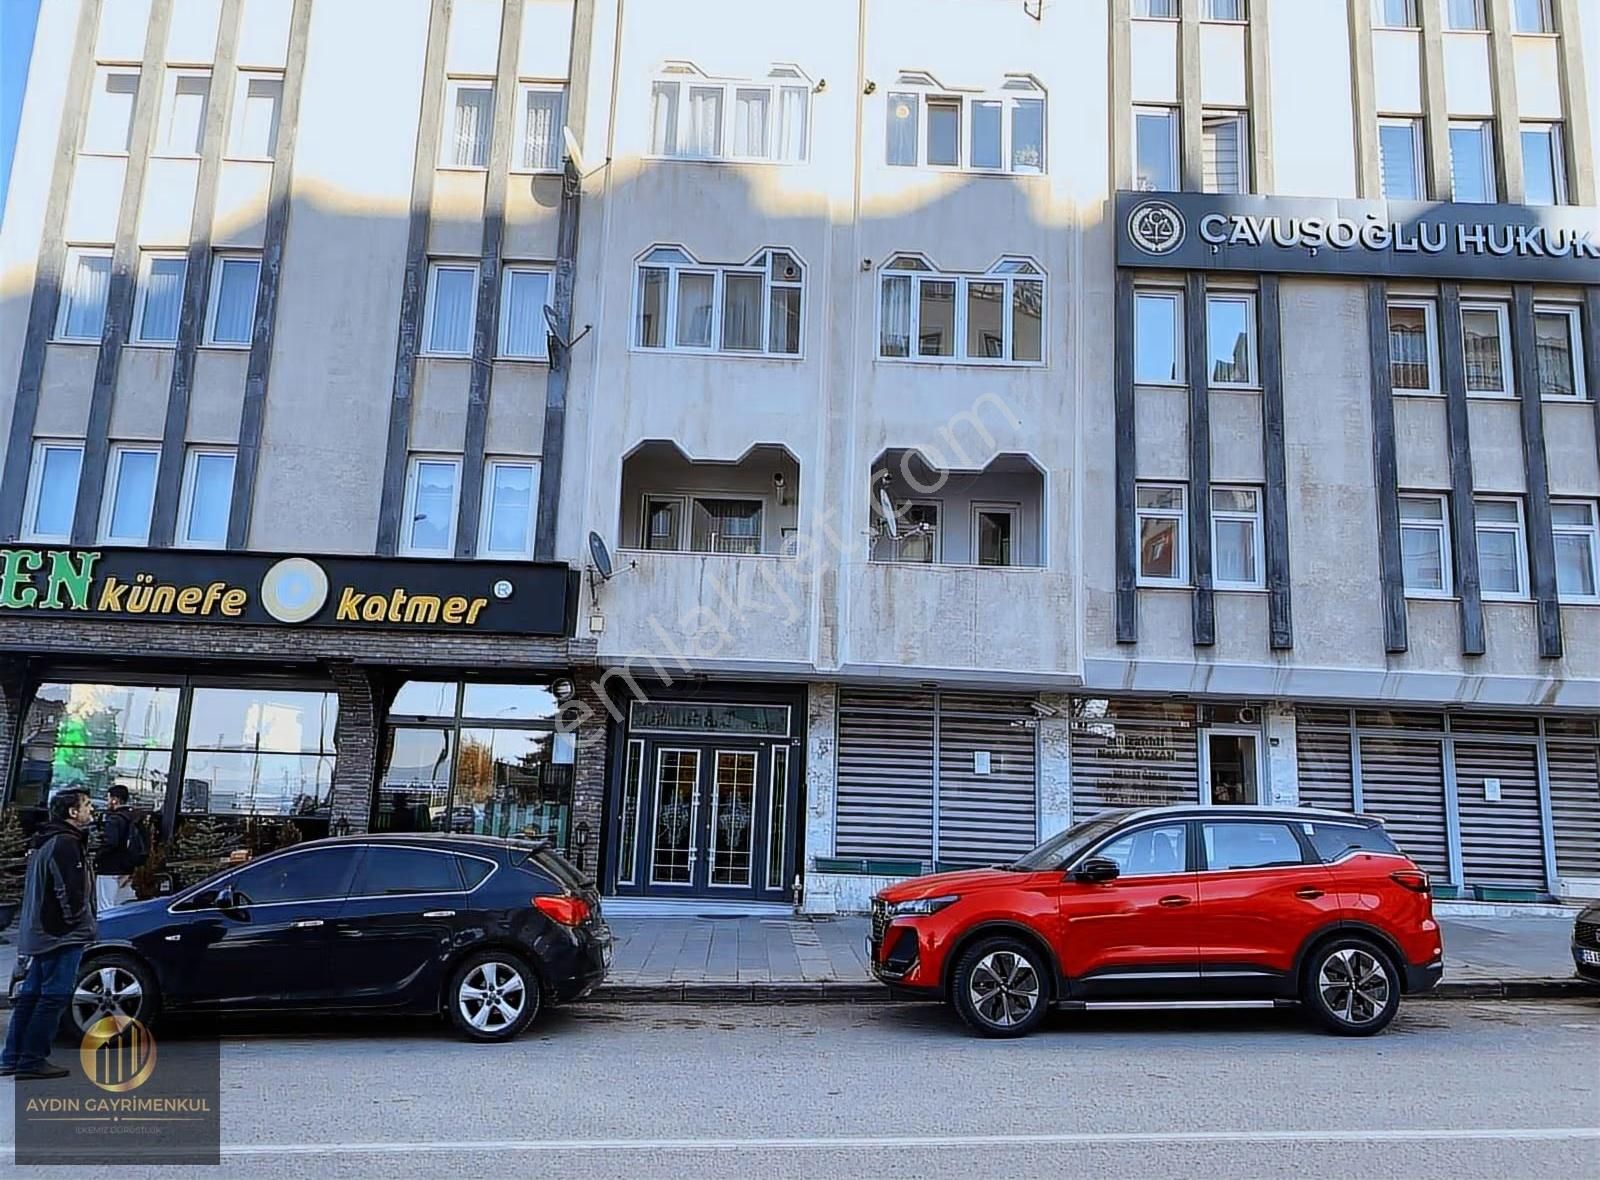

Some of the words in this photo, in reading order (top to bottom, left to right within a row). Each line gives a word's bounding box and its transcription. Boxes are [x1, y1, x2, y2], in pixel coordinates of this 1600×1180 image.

[1199, 213, 1448, 257] ÇAVUŞOĞLU
[1456, 221, 1600, 258] HUKUK
[98, 574, 247, 616] künefe
[336, 588, 487, 625] katmer
